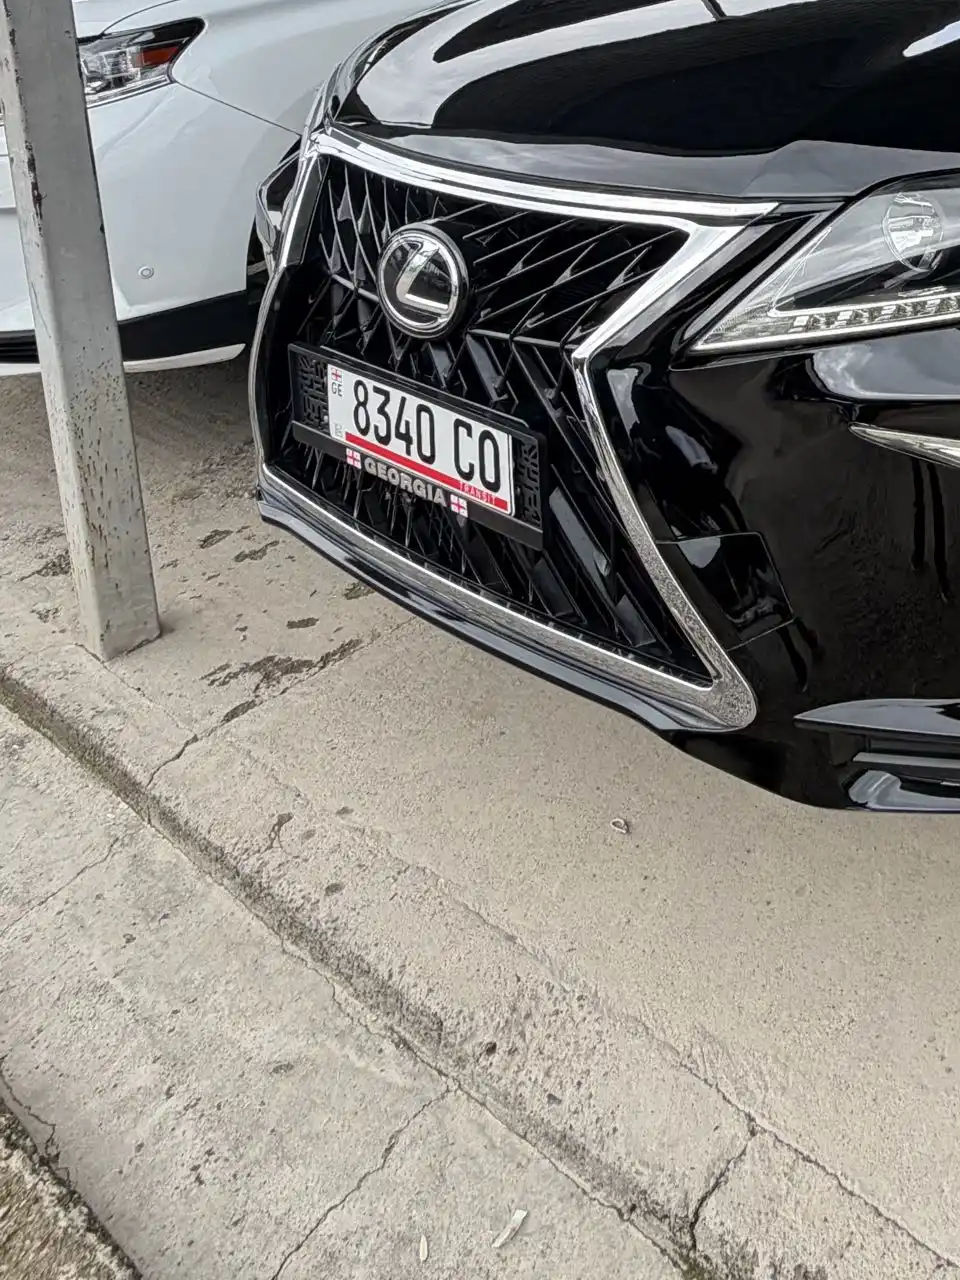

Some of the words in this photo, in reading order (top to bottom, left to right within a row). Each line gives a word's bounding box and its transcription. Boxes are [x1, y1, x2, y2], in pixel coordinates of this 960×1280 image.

[331, 381, 343, 398] GE
[353, 379, 437, 466] 8340
[453, 418, 501, 493] CO
[364, 457, 448, 508] GEORGIA
